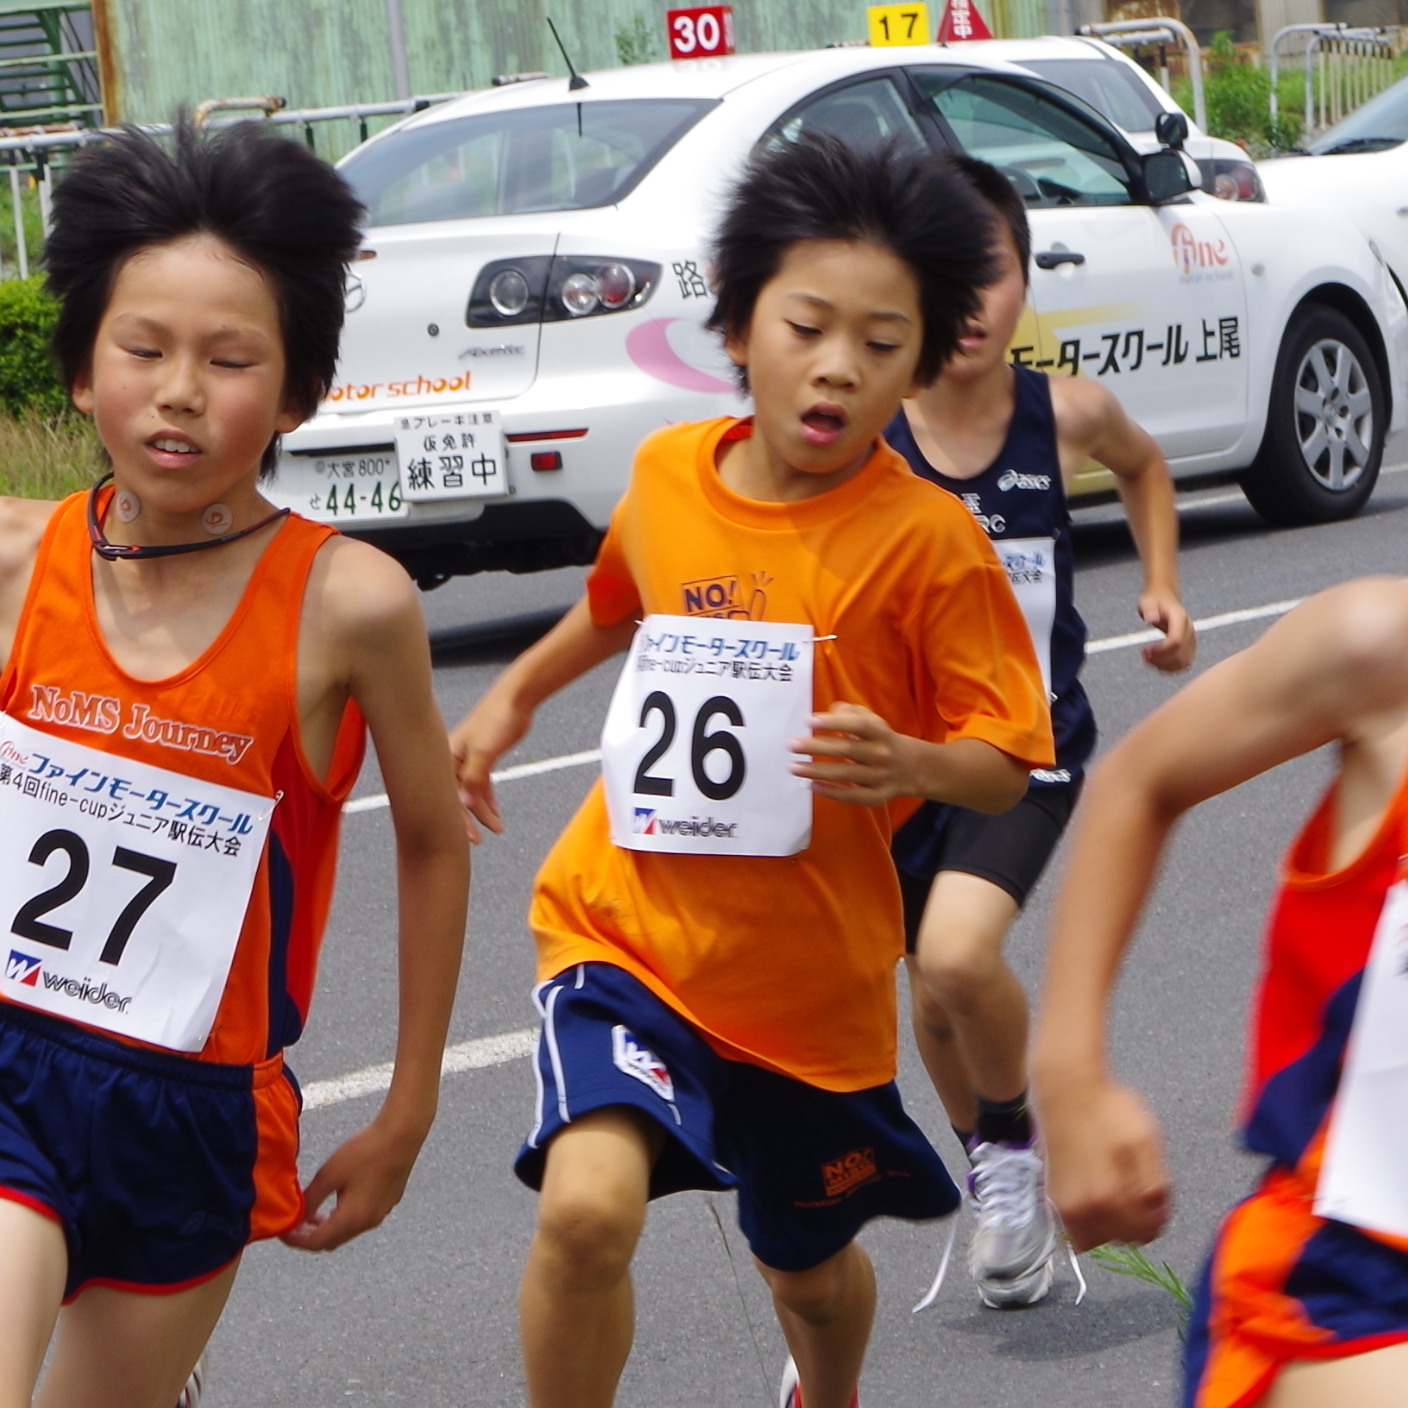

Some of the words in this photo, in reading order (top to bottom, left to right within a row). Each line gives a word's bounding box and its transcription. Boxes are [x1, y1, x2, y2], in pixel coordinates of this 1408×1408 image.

[673, 13, 720, 53] 30
[878, 12, 919, 40] 17
[1195, 316, 1241, 362] 上尾
[325, 383, 383, 402] otor
[387, 371, 471, 398] school
[407, 453, 497, 491] 練習中
[29, 685, 121, 735] NoMS
[123, 703, 254, 765] Journey
[633, 690, 746, 801] 26
[27, 752, 254, 837] ファインモータースクール
[10, 828, 178, 967] 27
